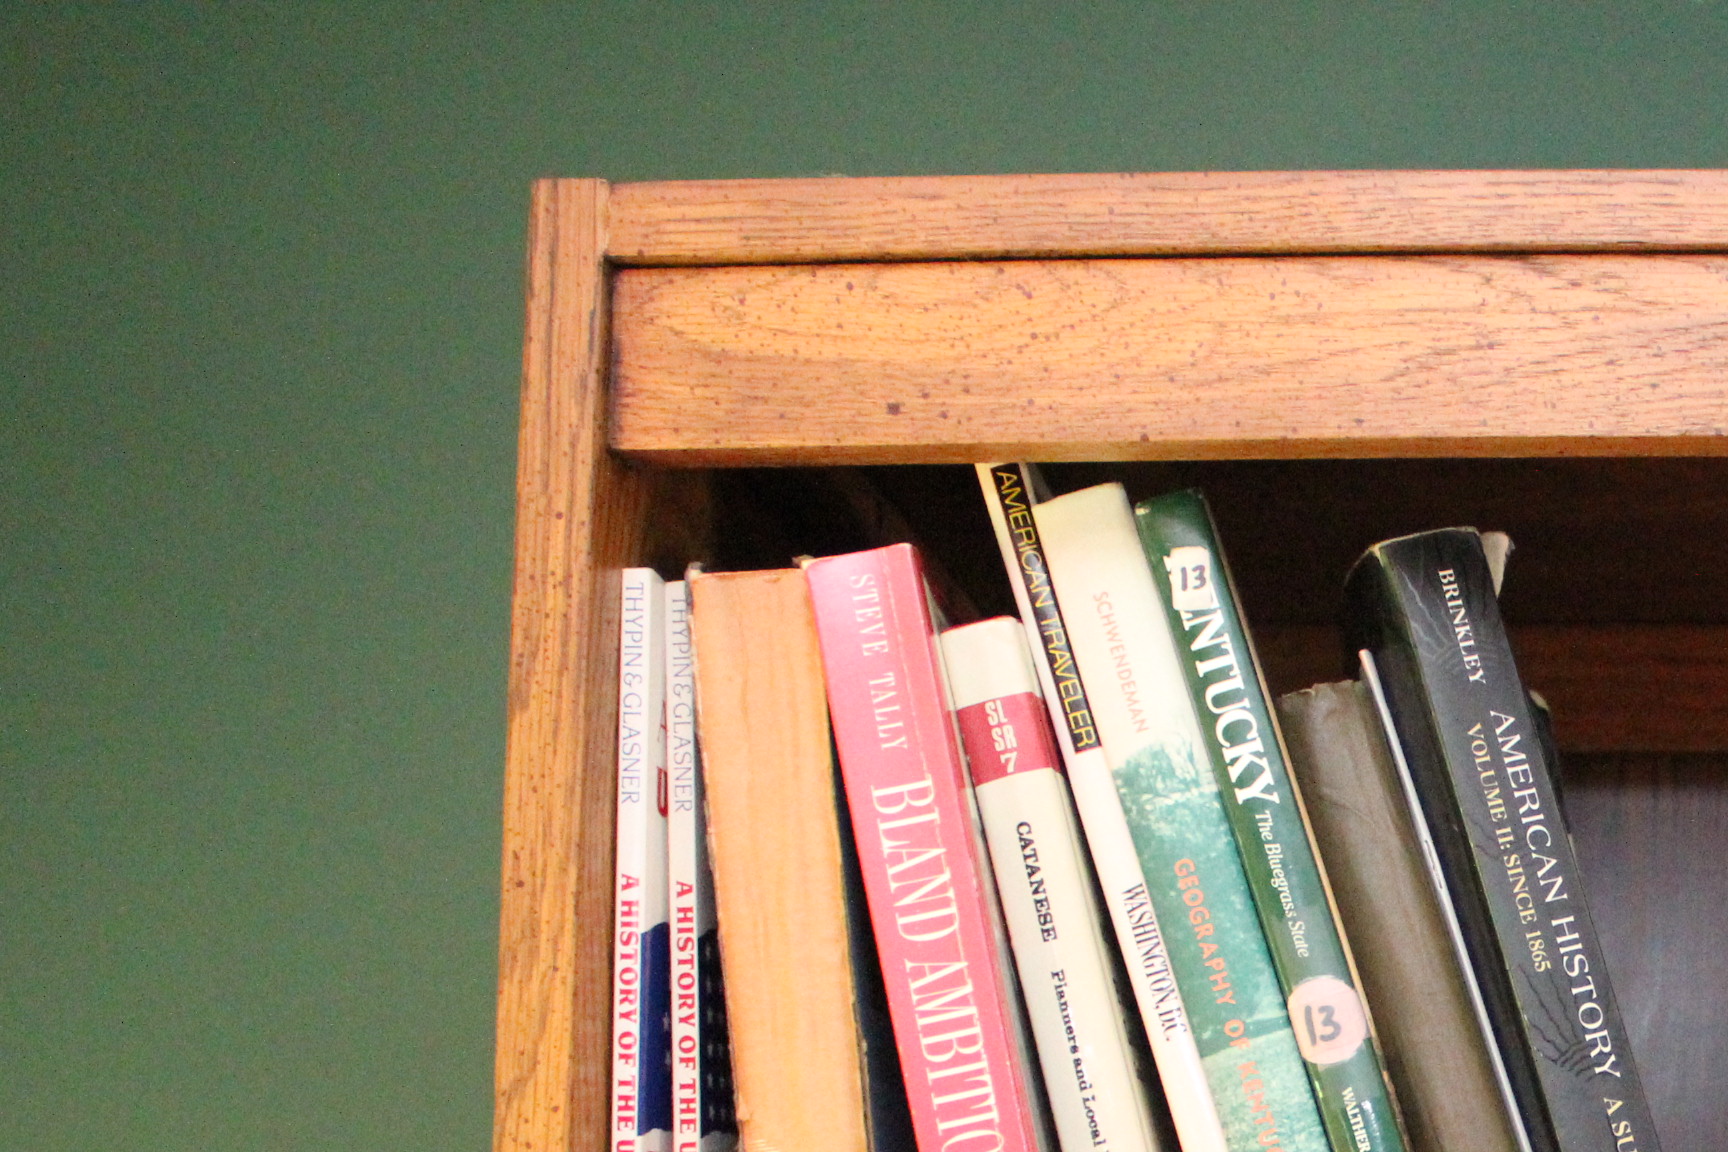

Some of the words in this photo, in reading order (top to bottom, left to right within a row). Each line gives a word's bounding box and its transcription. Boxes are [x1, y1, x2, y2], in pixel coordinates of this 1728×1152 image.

[996, 471, 1055, 608] AMERICAN
[1040, 612, 1097, 748] TRAVELER
[1180, 565, 1206, 591] 13
[624, 582, 644, 667] THYPIN
[850, 573, 889, 656] STEVE
[1438, 568, 1487, 684] BRINKLEY
[623, 673, 642, 689] &
[673, 683, 691, 698] &
[1093, 591, 1150, 734] SCHWENDEMAN
[1163, 555, 1280, 805] NTUCKY
[868, 672, 908, 751] TALLY
[985, 700, 1008, 726] SL
[991, 724, 1018, 751] SR
[621, 692, 642, 804] GLASNER
[673, 703, 694, 813] GLASNER
[1000, 751, 1018, 773] 7
[1467, 722, 1508, 823] VOLUME
[871, 773, 963, 942] BLAND
[1495, 826, 1515, 850] II:
[621, 874, 639, 891] A
[676, 881, 693, 898] A
[1016, 821, 1057, 942] CATANESE
[1255, 809, 1273, 841] The
[1264, 843, 1296, 918] Bluegrass
[1288, 920, 1309, 958] State
[1490, 710, 1568, 903] AMERICAN
[1551, 915, 1621, 1079] HISTORY
[1504, 853, 1538, 925] SINCE
[619, 900, 639, 1024] HISTORY
[676, 906, 696, 1028] HISTORY
[1121, 883, 1178, 1009] WASHINGTON,
[1174, 857, 1236, 1006] GEOGRAPHY
[1224, 1019, 1251, 1050] OF
[1525, 930, 1552, 973] 1865
[617, 1031, 637, 1067] OF
[678, 1035, 696, 1070] OF
[1304, 1005, 1341, 1046] 13
[617, 1075, 636, 1132] THE
[679, 1078, 697, 1134] THE
[1073, 1057, 1093, 1092] and
[1603, 1094, 1622, 1117] A
[1082, 1095, 1107, 1148] Local
